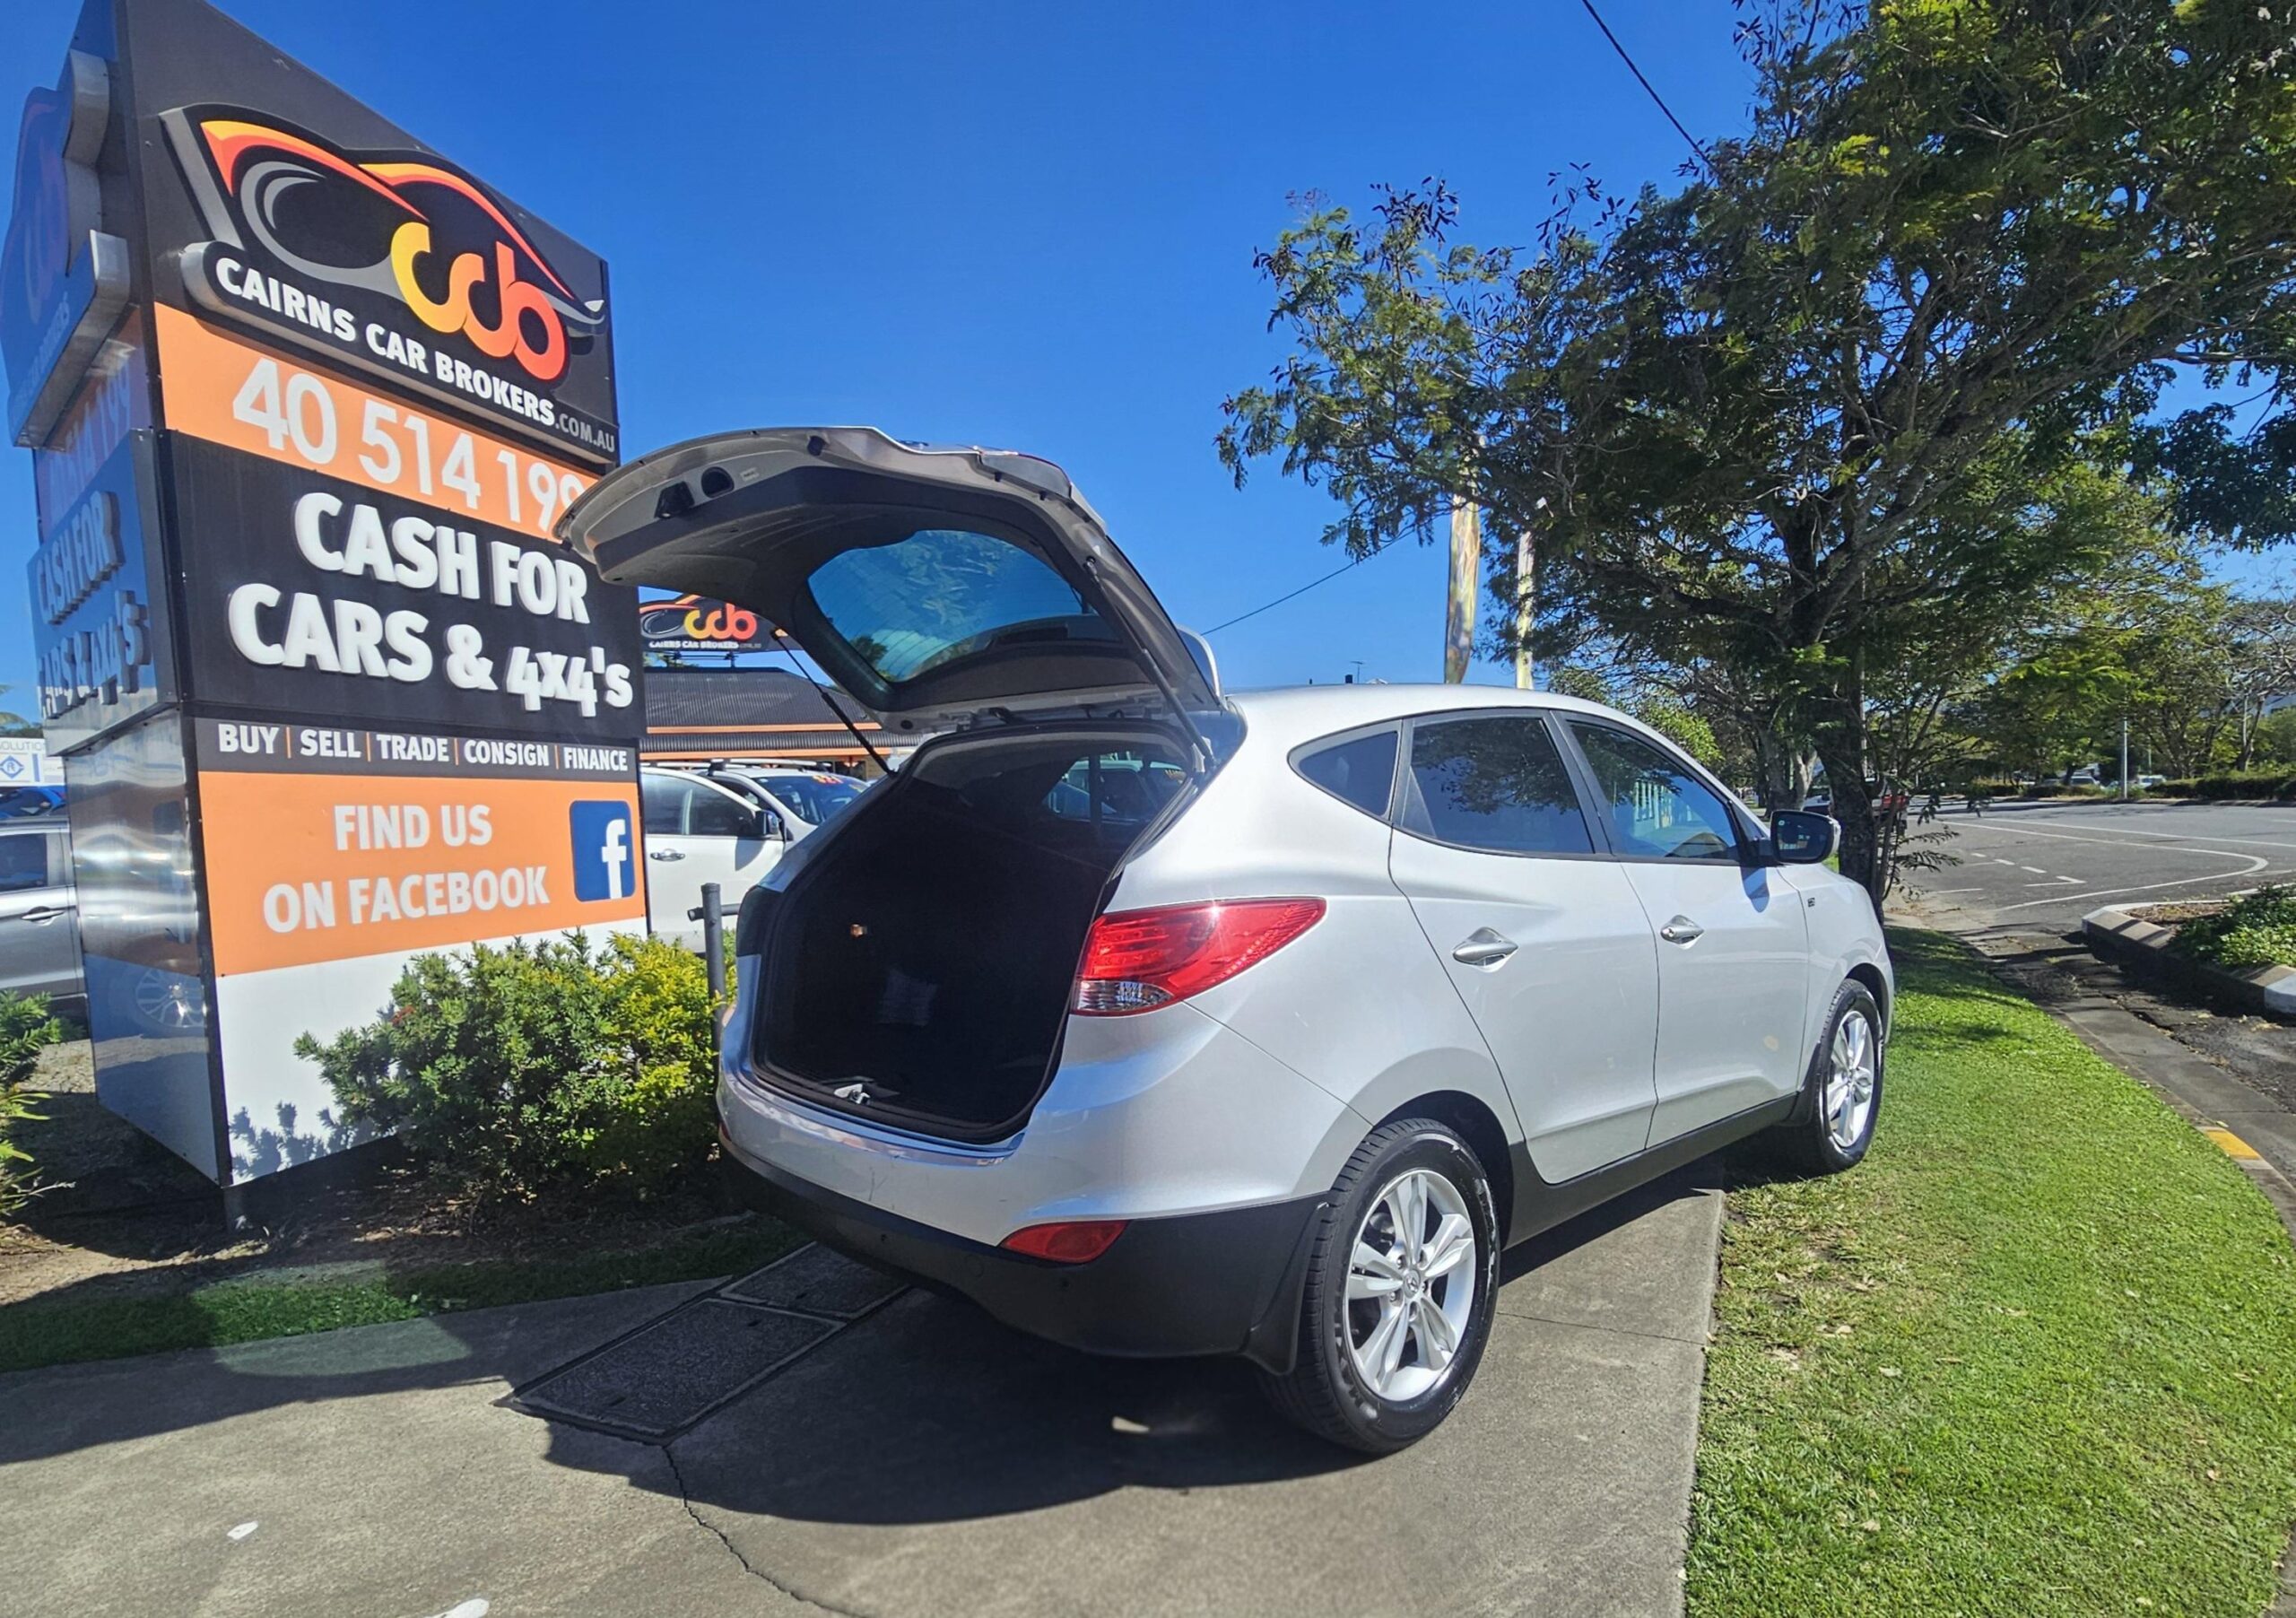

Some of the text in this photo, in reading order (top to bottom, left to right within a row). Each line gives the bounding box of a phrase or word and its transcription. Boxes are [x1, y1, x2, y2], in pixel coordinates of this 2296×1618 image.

[216, 257, 356, 342] CAIRNS
[366, 324, 428, 374] CAR
[435, 351, 553, 426] BROKERS
[232, 357, 336, 465] 40
[359, 398, 481, 509] 514
[295, 492, 590, 623] CASH FOR
[229, 583, 433, 683] CARS
[446, 624, 498, 690] &
[218, 723, 629, 771] BUY SELL TRADE CONSIGN FINANCE
[334, 804, 492, 851] FIND US
[263, 866, 551, 934] ON FACEBOOK
